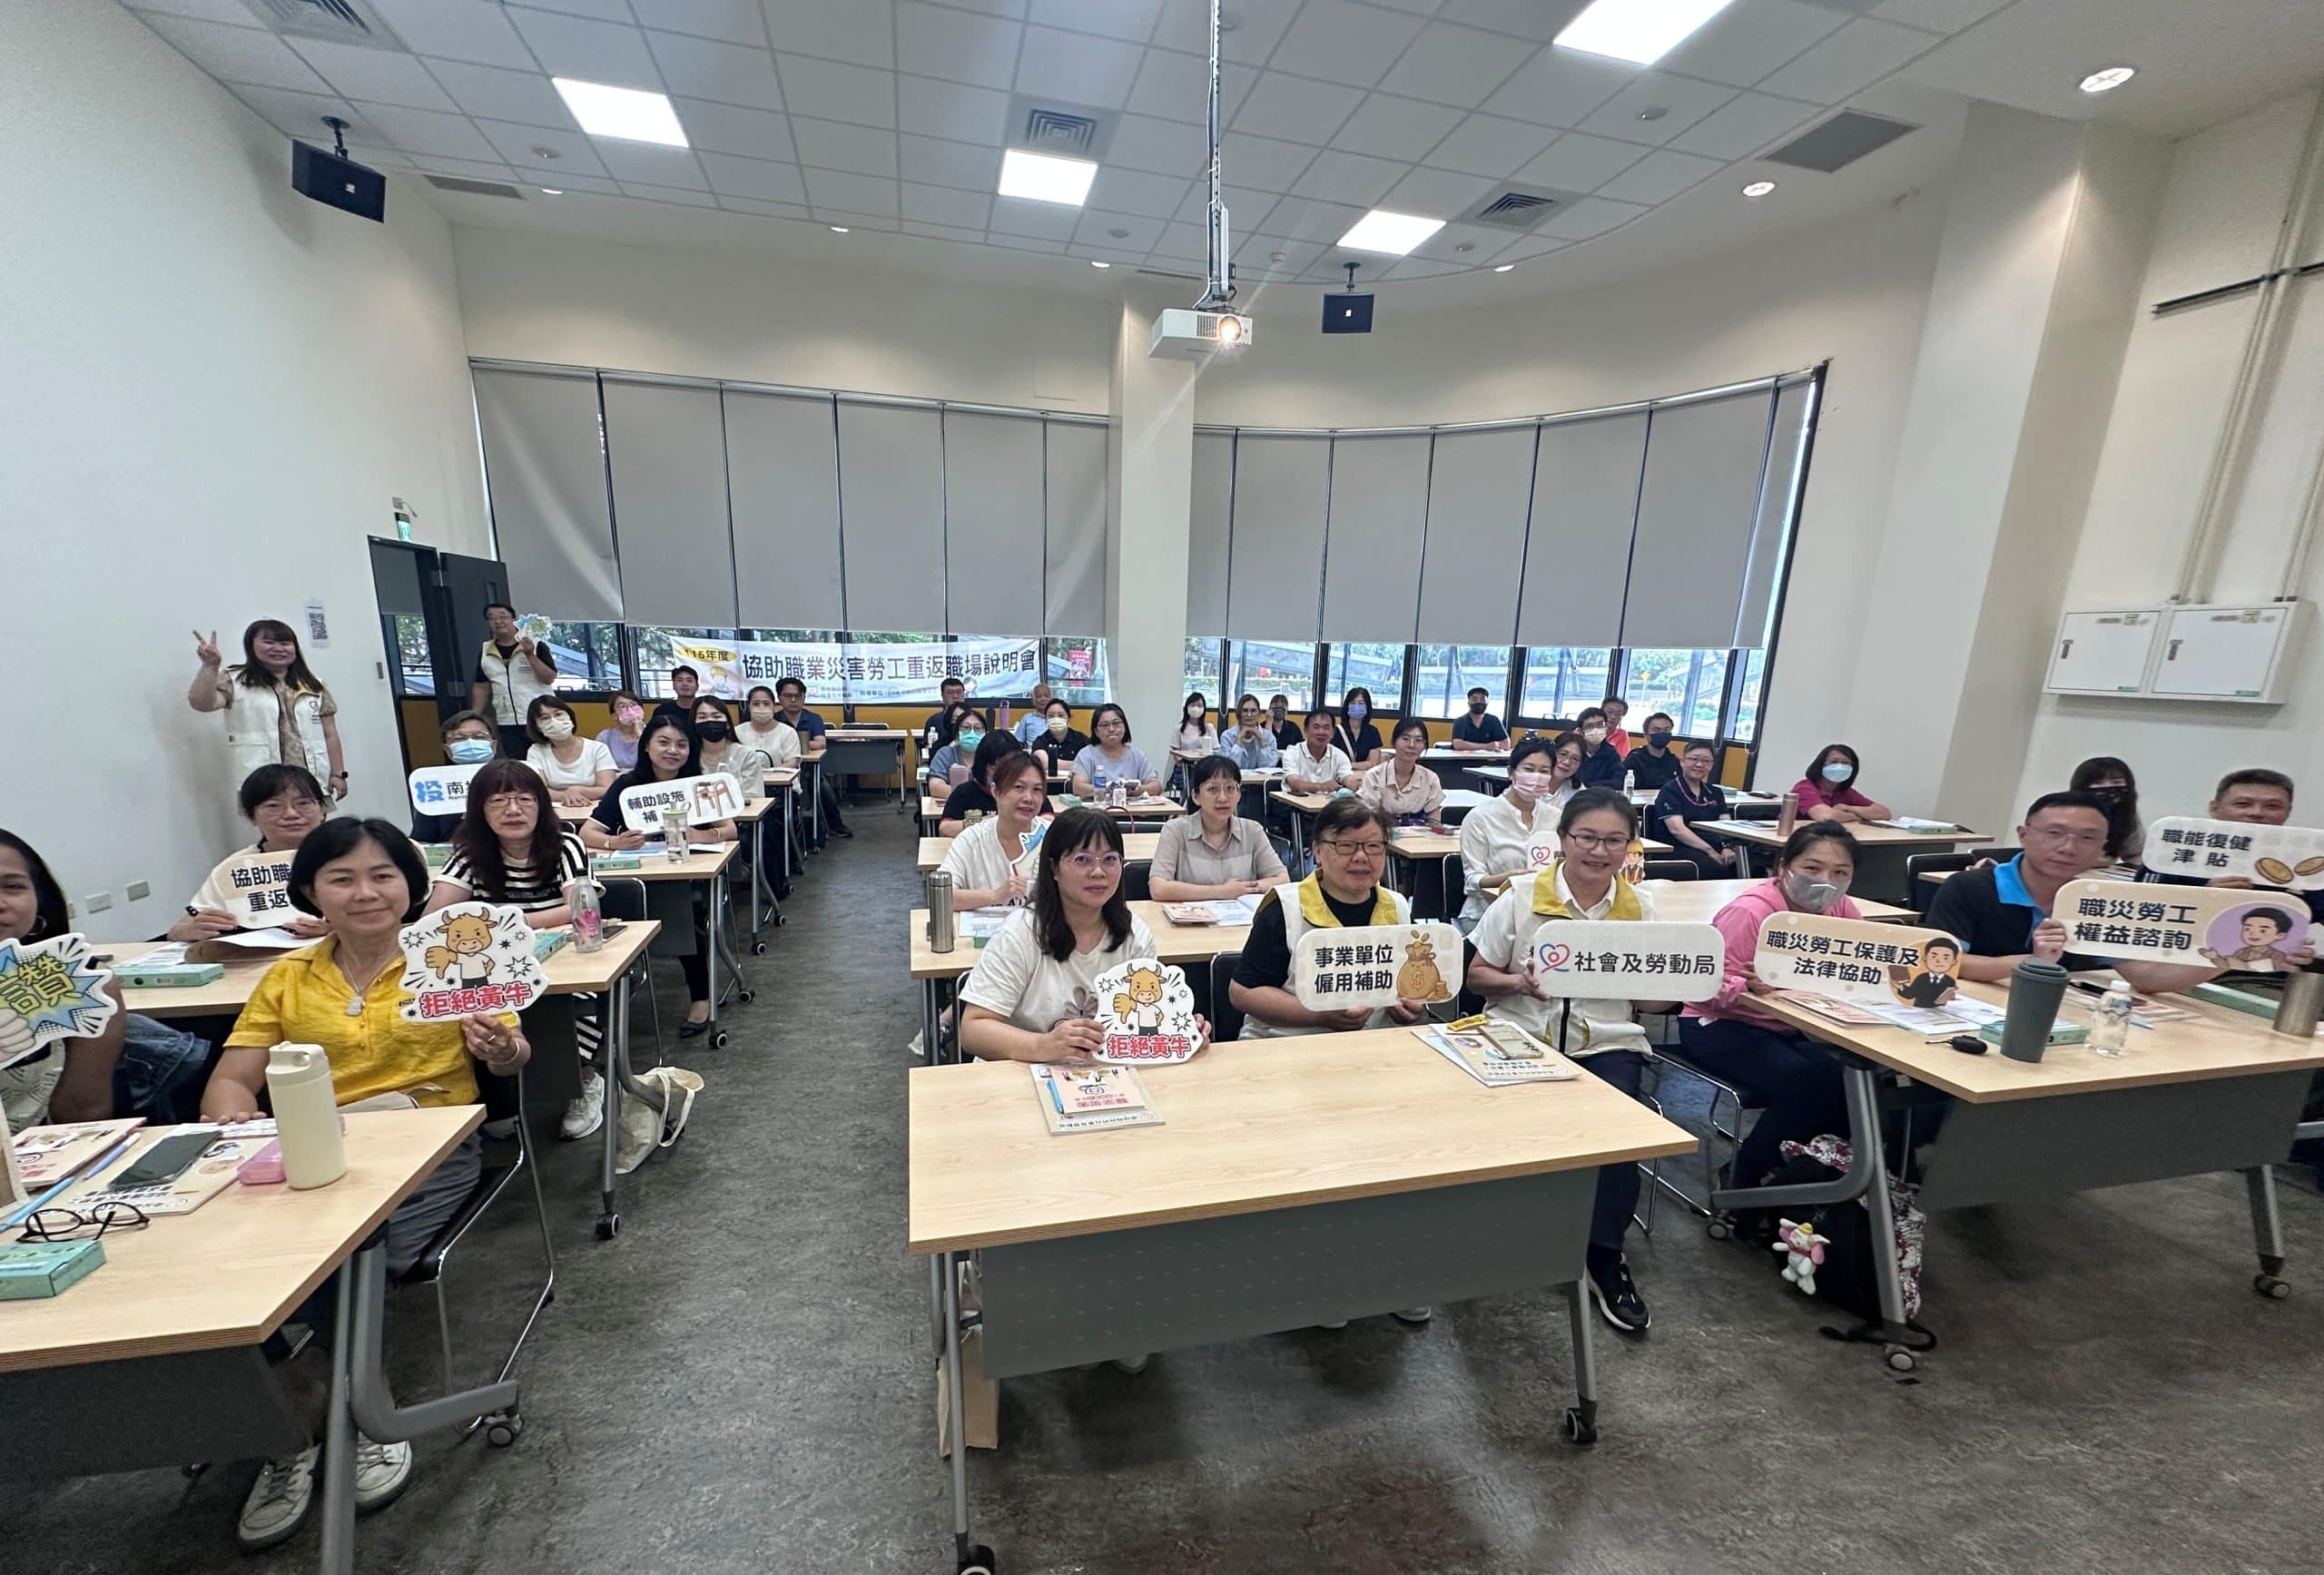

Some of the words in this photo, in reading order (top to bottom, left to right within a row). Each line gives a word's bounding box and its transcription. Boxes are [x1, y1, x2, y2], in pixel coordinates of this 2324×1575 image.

[742, 649, 1036, 681] 協助職業災害勞工重返職場說明會
[446, 781, 471, 795] 南
[627, 791, 685, 811] 輔助設施
[2161, 829, 2252, 851] 職能復健
[2077, 898, 2198, 925] 職災勞工
[2073, 921, 2192, 950] 權益諮詢
[1314, 944, 1393, 968] 事業單位
[1766, 930, 1920, 968] 職災勞工保護及
[1574, 951, 1716, 976] 社會及勞動局
[1793, 957, 1882, 986] 法律協助
[1314, 970, 1393, 994] 僱用補助
[419, 980, 533, 1019] 拒絕黃牛
[1107, 1034, 1191, 1059] 拒絕黃牛
